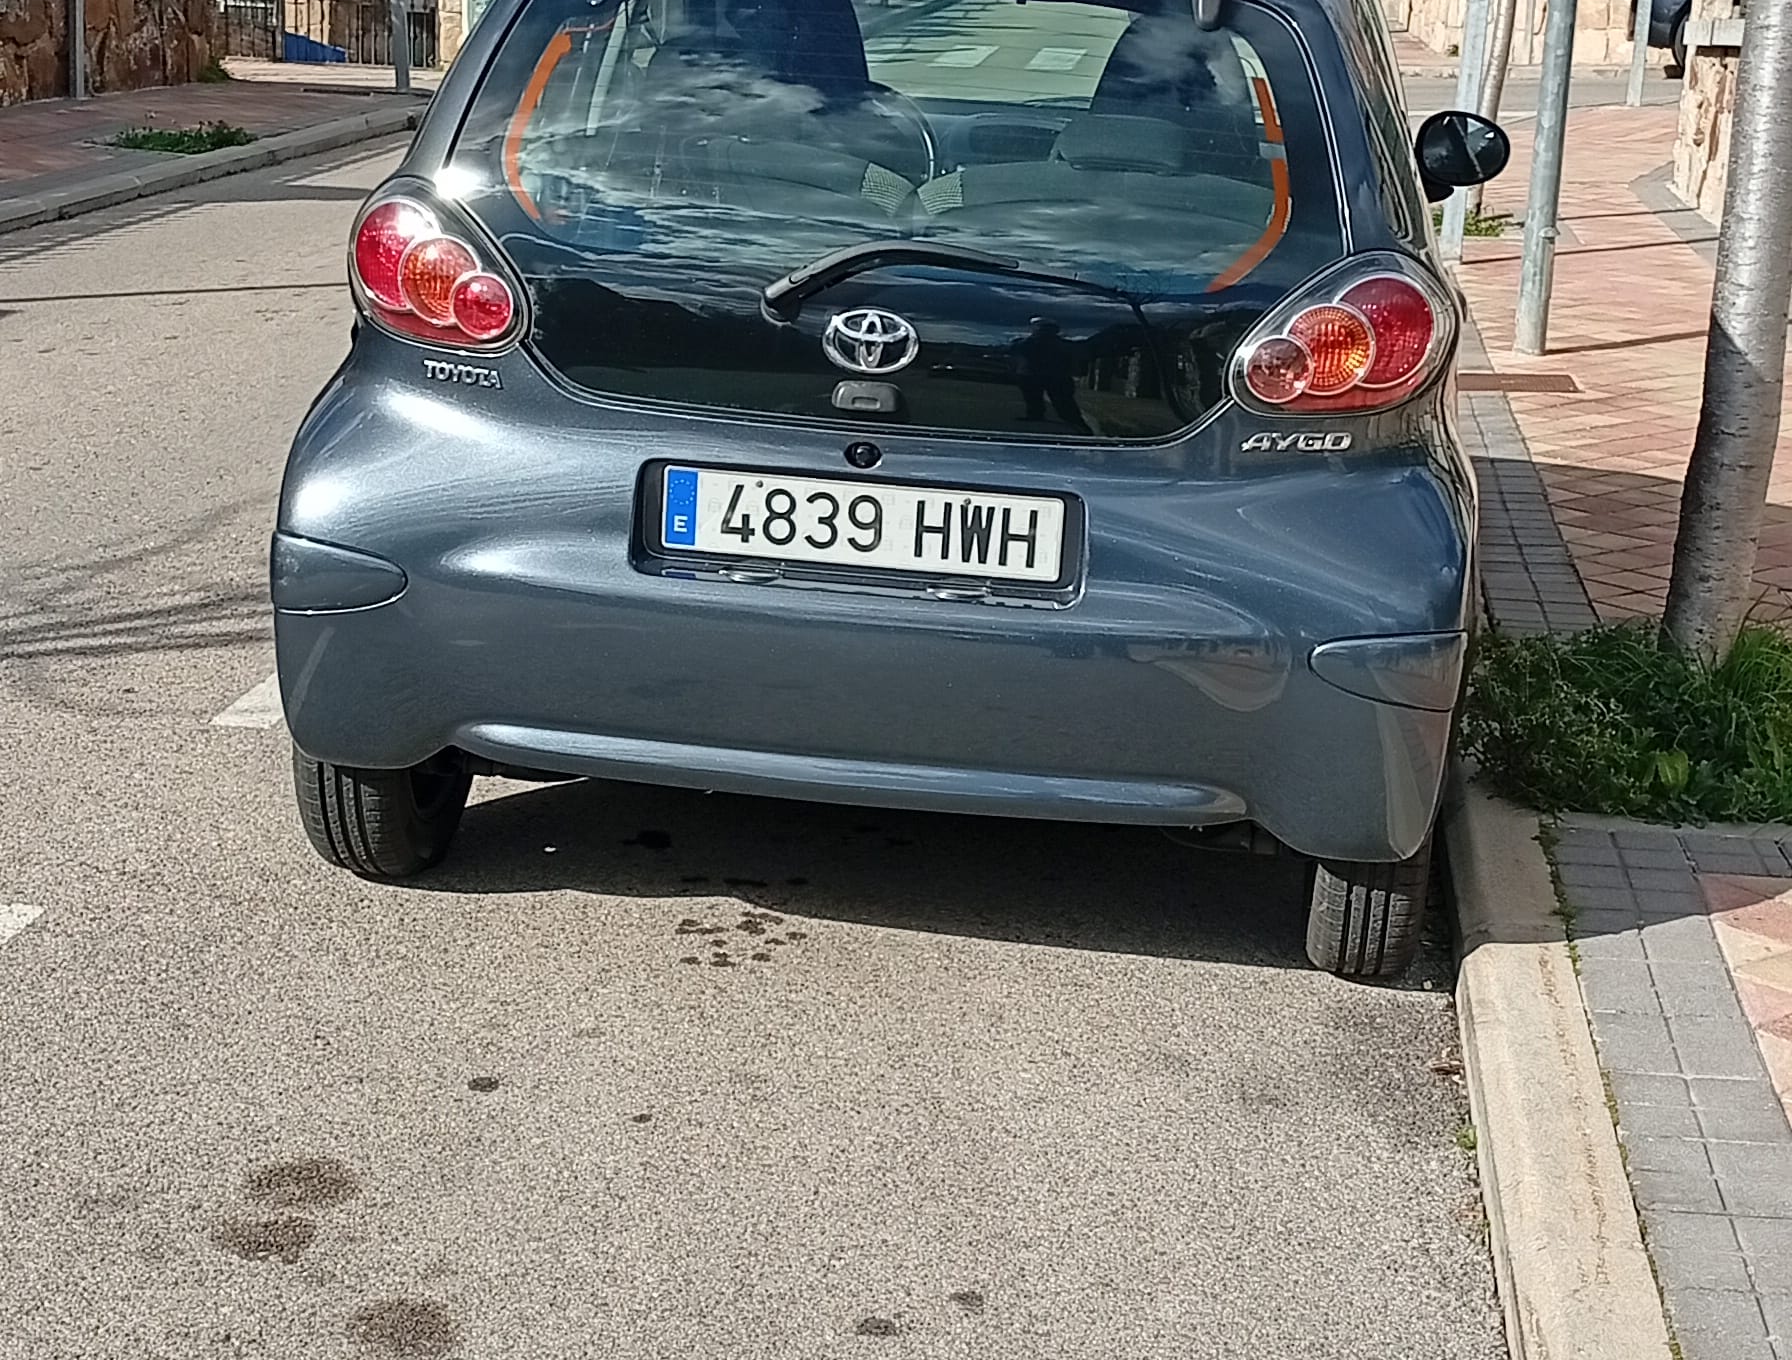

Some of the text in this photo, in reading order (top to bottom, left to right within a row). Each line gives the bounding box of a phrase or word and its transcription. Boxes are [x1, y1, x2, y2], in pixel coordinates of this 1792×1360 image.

[423, 359, 502, 389] TOYOTA
[1241, 432, 1352, 451] AYGO
[673, 484, 1039, 569] E 4839 HWH
